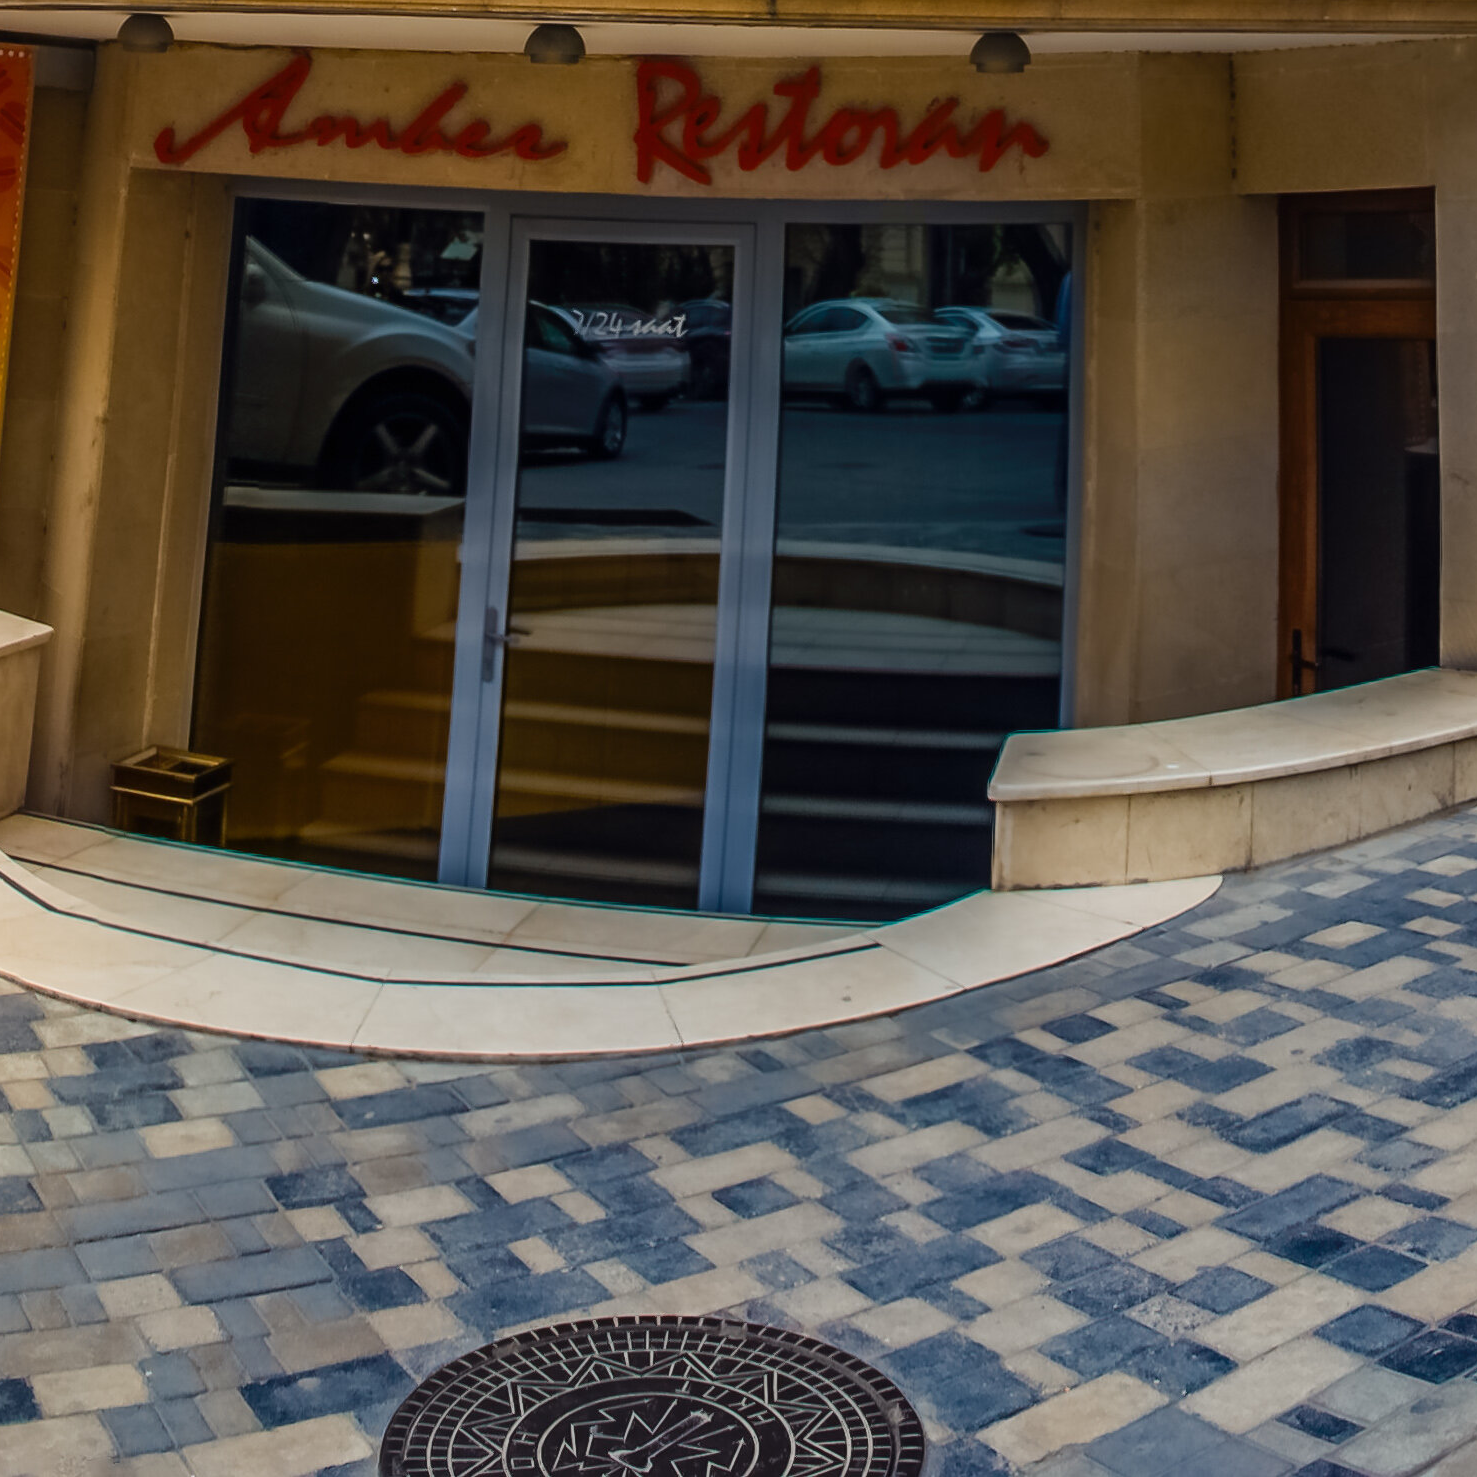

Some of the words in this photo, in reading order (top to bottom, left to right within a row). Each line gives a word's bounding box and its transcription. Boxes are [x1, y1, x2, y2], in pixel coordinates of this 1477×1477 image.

[154, 51, 568, 166] Amber
[634, 58, 1051, 185] Restoran
[571, 309, 622, 338] 7/24
